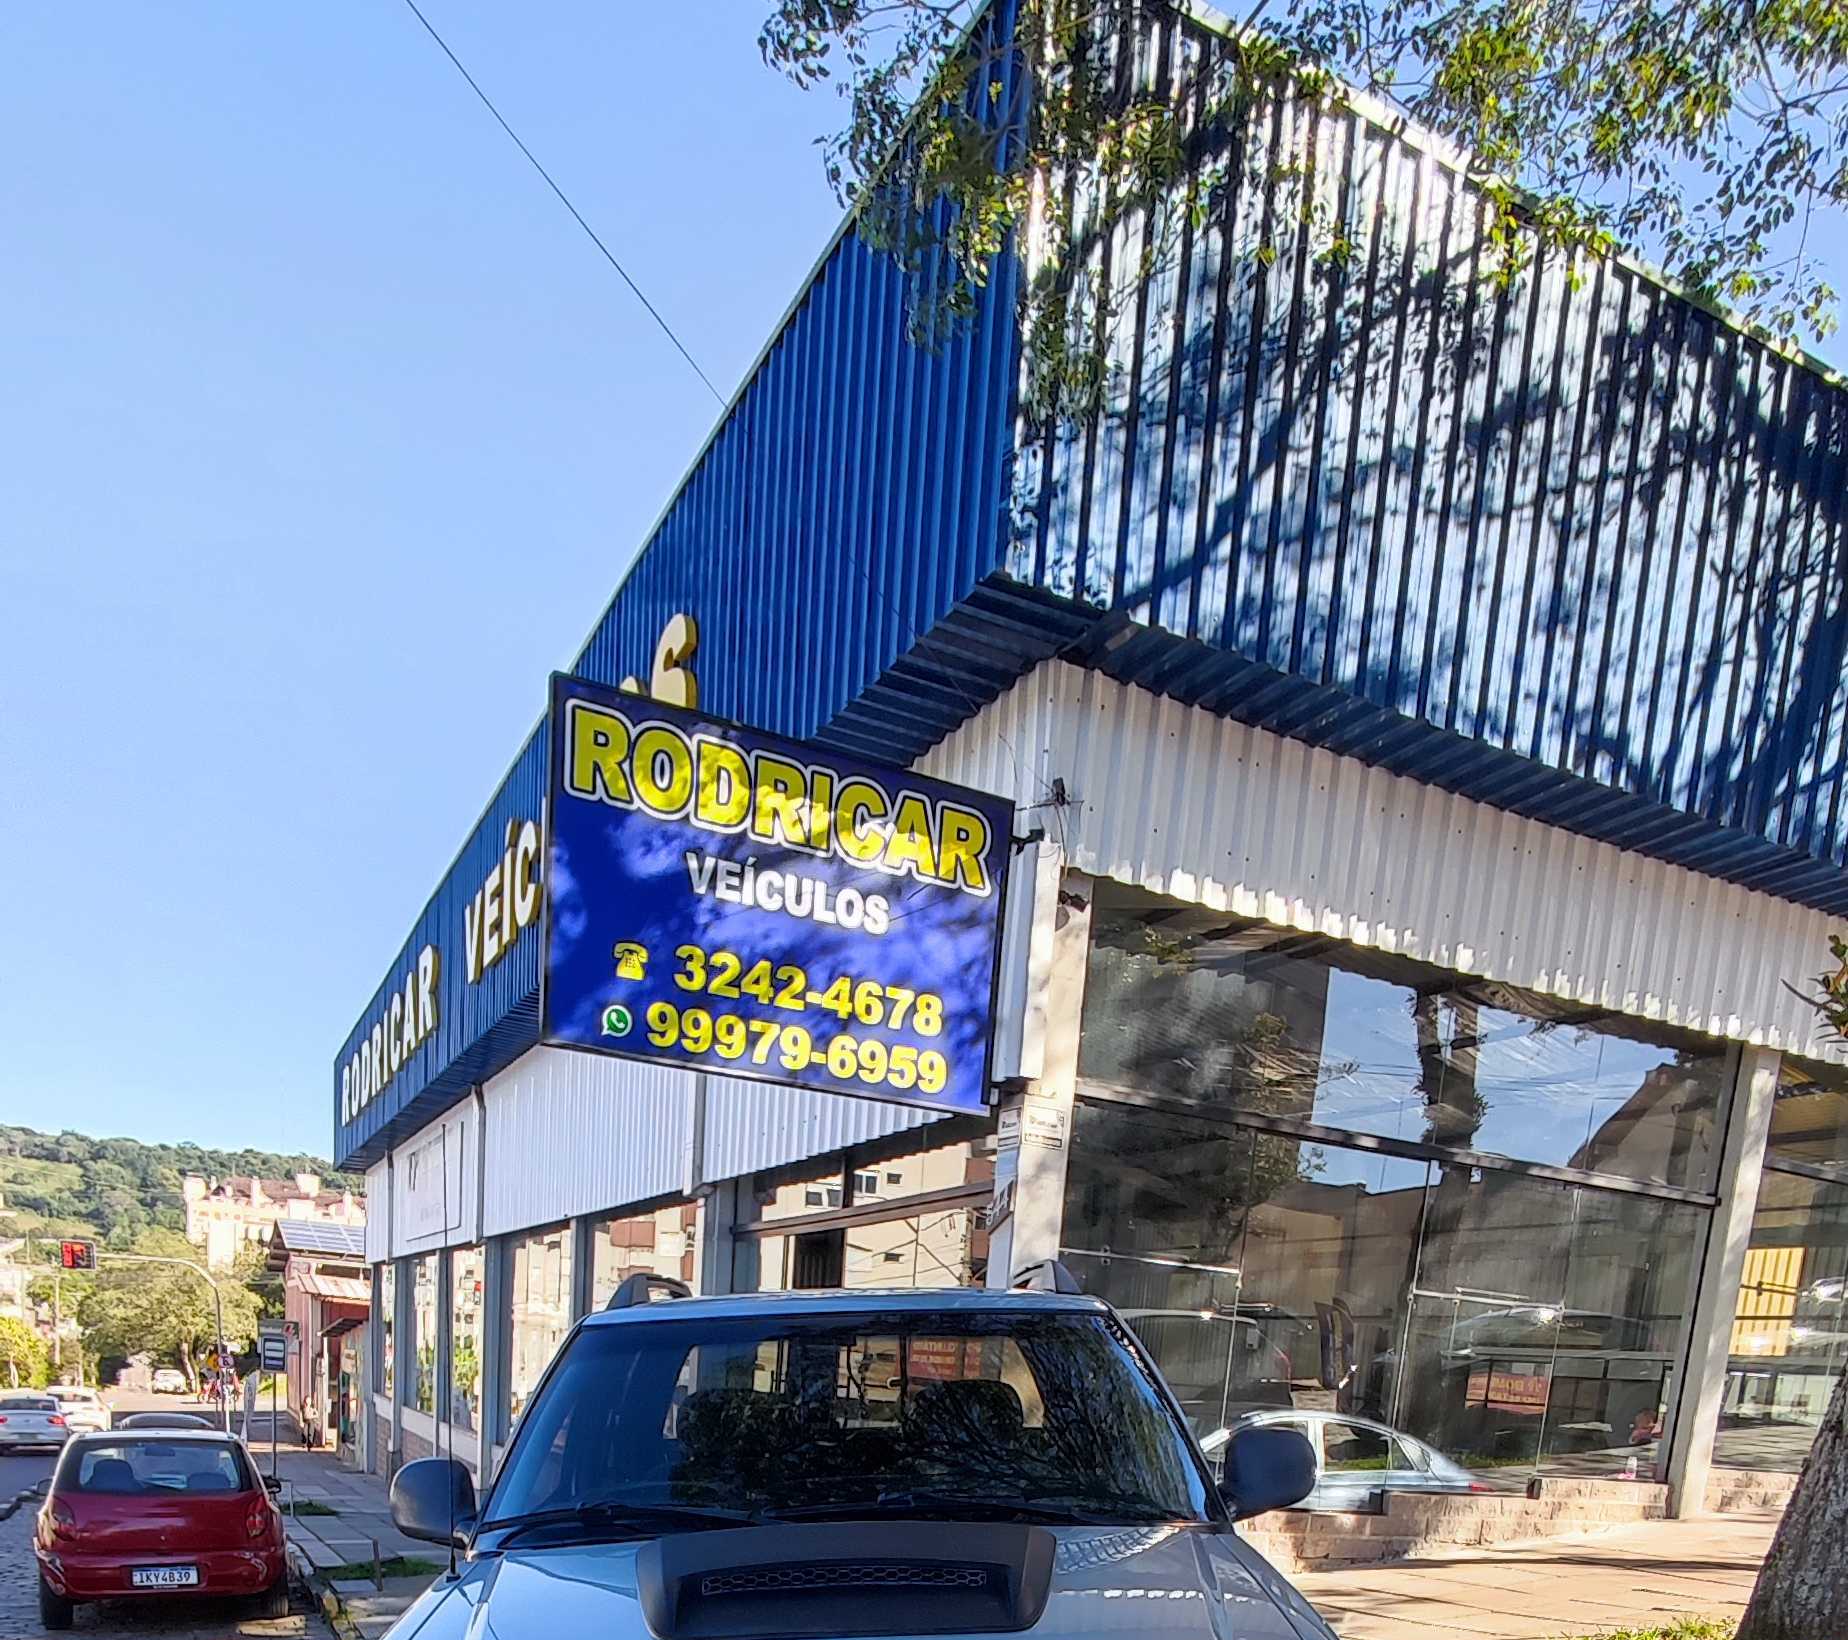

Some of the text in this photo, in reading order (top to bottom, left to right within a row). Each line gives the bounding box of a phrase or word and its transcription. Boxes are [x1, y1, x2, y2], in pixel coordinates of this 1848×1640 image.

[567, 703, 989, 893] RODRICAR
[685, 849, 890, 935] VEÍCULOS
[341, 944, 438, 1127] RODRICAR
[673, 943, 944, 1038] 3242-4678
[645, 1001, 948, 1095] 99979-6959
